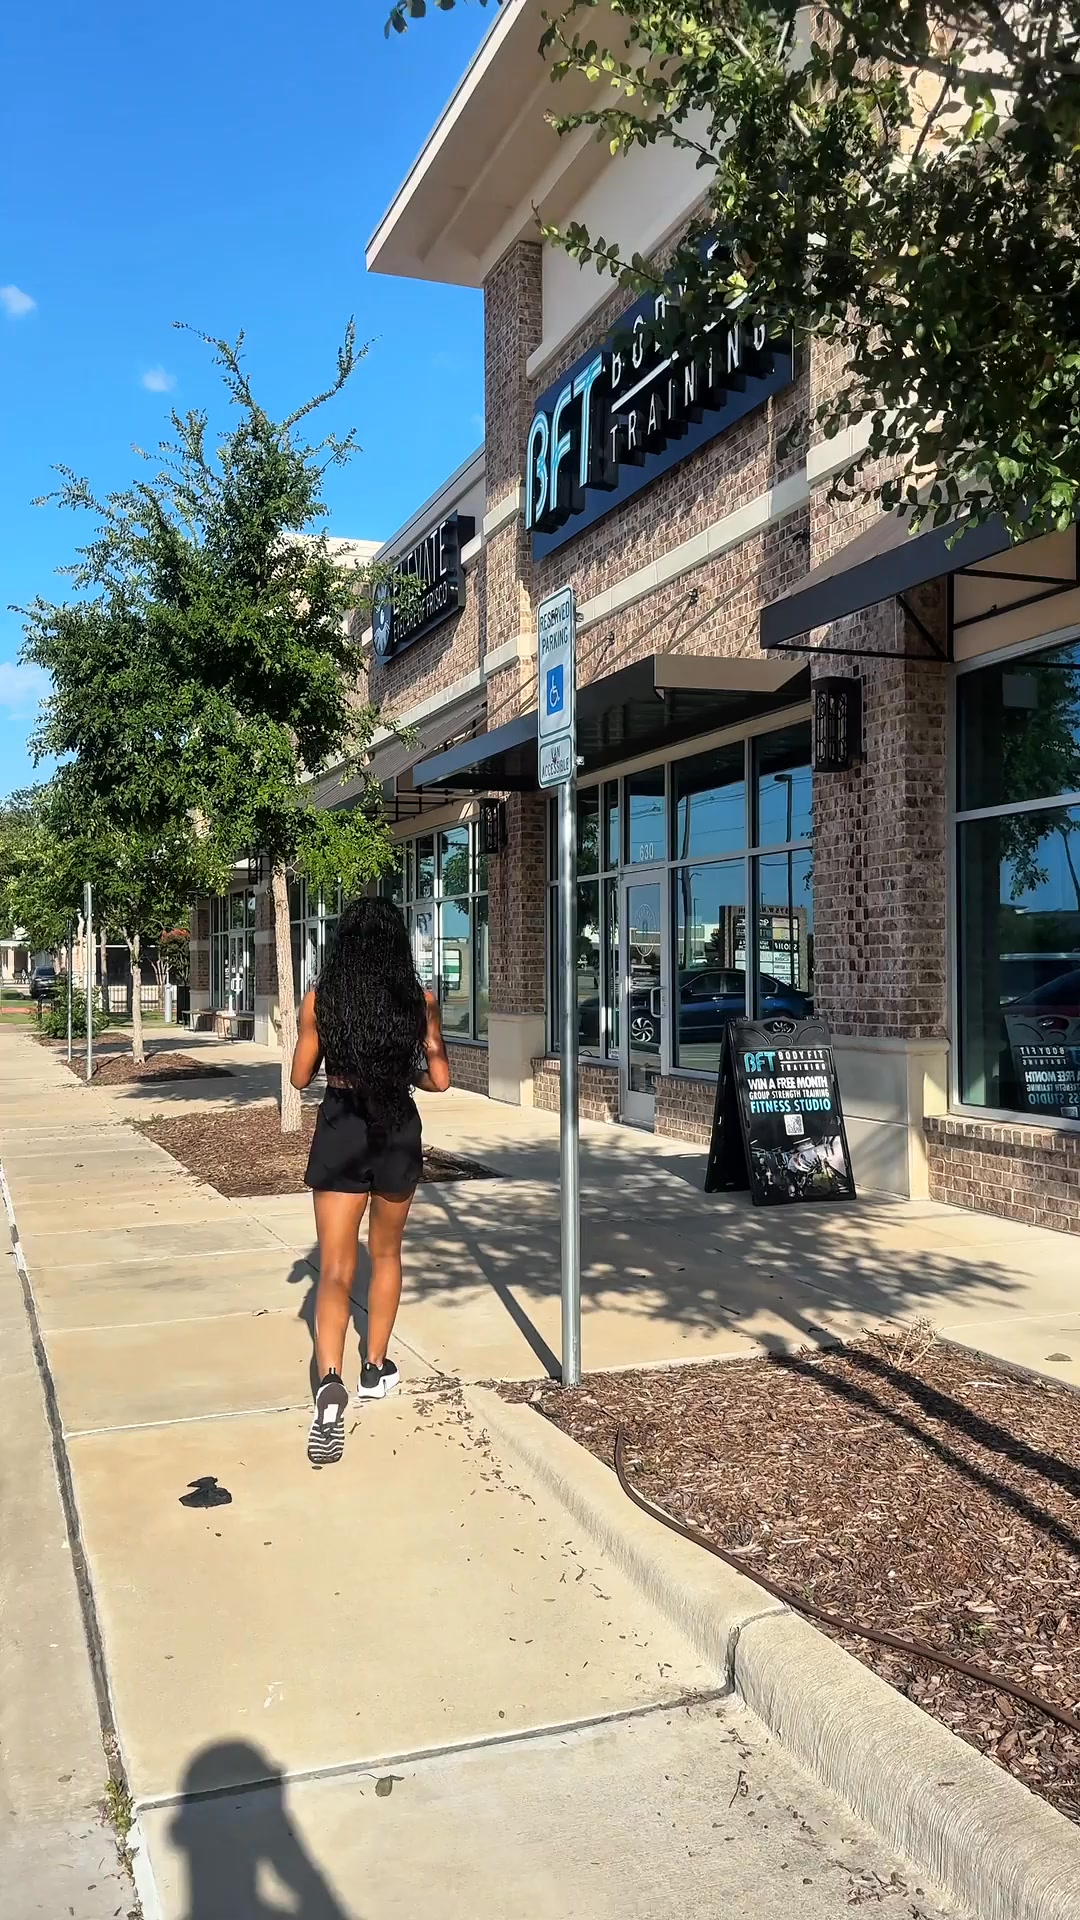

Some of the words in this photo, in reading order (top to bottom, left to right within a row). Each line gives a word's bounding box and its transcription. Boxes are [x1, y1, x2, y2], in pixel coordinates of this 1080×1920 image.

[525, 353, 602, 532] BFT
[426, 581, 448, 618] FRISCO
[540, 601, 570, 632] RESERVED
[541, 626, 569, 656] PARKING
[551, 745, 561, 759] VAN
[541, 757, 569, 778] ACCESSIBLE
[640, 843, 654, 862] 630
[744, 1051, 776, 1072] BFT
[778, 1050, 804, 1060] BODY
[807, 1050, 824, 1059] FIT
[780, 1063, 826, 1071] TRAINING
[748, 1078, 768, 1090] WIN
[769, 1077, 777, 1090] A
[776, 1077, 797, 1089] FREE
[796, 1075, 829, 1089] MONTH
[749, 1090, 770, 1100] GROUP
[772, 1089, 801, 1099] STRENGTH
[802, 1088, 830, 1098] TRAINING
[750, 1100, 791, 1113] FITNESS
[793, 1098, 831, 1111] STUDIO
